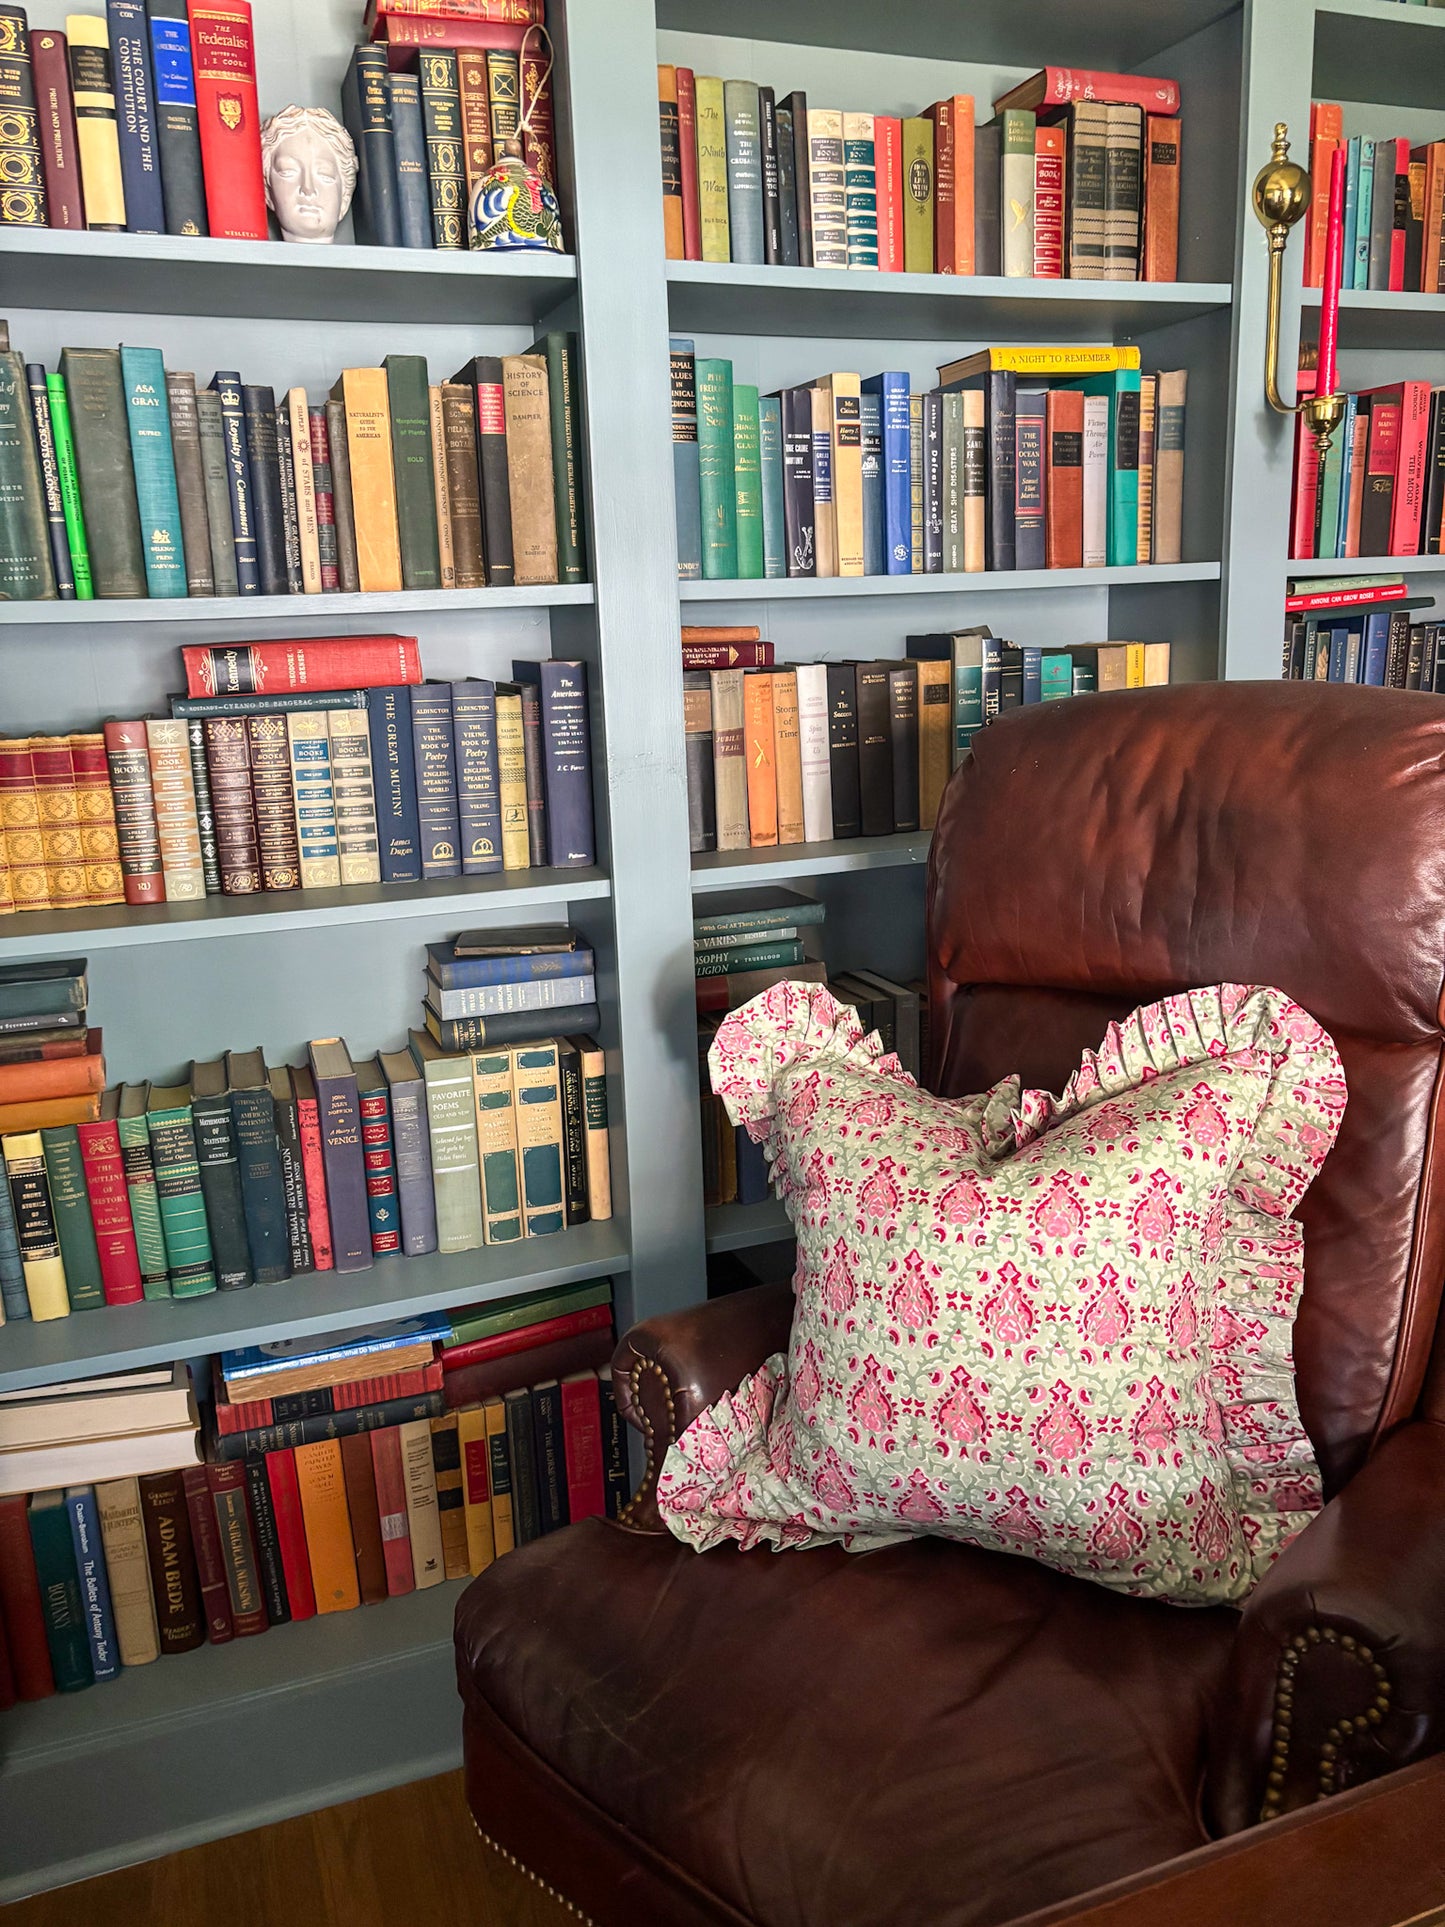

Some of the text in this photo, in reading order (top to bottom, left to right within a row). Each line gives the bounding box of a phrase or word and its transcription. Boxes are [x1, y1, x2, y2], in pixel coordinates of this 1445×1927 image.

[198, 32, 249, 49] Federalist
[131, 38, 142, 65] THE
[118, 37, 138, 134] CONSTITUTION
[134, 69, 147, 112] COURT
[700, 108, 718, 120] The
[52, 111, 60, 130] AND
[138, 114, 150, 143] AND
[701, 146, 726, 158] Ninth
[703, 180, 726, 192] Wave
[1010, 353, 1111, 364] A NIGHT TO REMEMBER
[506, 372, 543, 380] HISTORY
[6, 382, 16, 395] of
[135, 384, 155, 394] ASA
[520, 380, 529, 388] OF
[508, 389, 544, 398] SCIENCE
[131, 397, 159, 406] GRAY
[396, 418, 429, 426] Morphology
[1087, 419, 1107, 428] Victory
[967, 451, 974, 459] FE
[301, 458, 308, 466] of
[1022, 460, 1037, 468] WAR
[226, 418, 249, 536] Royalty for Commoners
[278, 455, 287, 510] COMPOSITION
[302, 469, 311, 496] STARS
[1406, 478, 1415, 505] MOON
[307, 515, 315, 534] MEN
[1310, 598, 1330, 606] ANYONE
[227, 650, 240, 692] Kennedy
[986, 689, 999, 716] THE
[775, 705, 798, 713] Storm
[783, 716, 794, 725] of
[385, 693, 403, 818] THE GREAT MUTINY
[425, 752, 448, 762] Poetry
[465, 749, 488, 759] Poetry
[114, 766, 145, 774] BOOKS
[390, 838, 411, 847] James
[703, 934, 738, 947] VARIES
[744, 954, 781, 962] TRUEBLOOD
[332, 1094, 346, 1102] JOHN
[432, 1090, 471, 1101] FAVORITE
[432, 1102, 460, 1111] POEMS
[241, 1111, 270, 1119] AMERICAN
[328, 1108, 353, 1116] NORWICH
[237, 1118, 274, 1126] GOVERNMENT
[328, 1136, 359, 1146] VENICE
[97, 1164, 113, 1172] THE
[89, 1174, 124, 1183] OUTLINE
[103, 1186, 114, 1194] OF
[22, 1201, 46, 1209] STORIES
[92, 1195, 127, 1205] HISTORY
[282, 1148, 302, 1268] THE PRIMAL REVOLUTION
[305, 1454, 335, 1465] PAINTED
[614, 1459, 620, 1467] is
[310, 1463, 332, 1471] CAVES
[609, 1469, 626, 1481] T
[101, 1506, 139, 1521] MAMMOTH
[103, 1517, 142, 1533] HUNTERS
[158, 1516, 184, 1614] ADAM BEDE
[228, 1520, 251, 1609] SURGICAL NURSING
[48, 1582, 71, 1630] BOTANY
[84, 1560, 107, 1661] The Ballets of Antony Tudor
